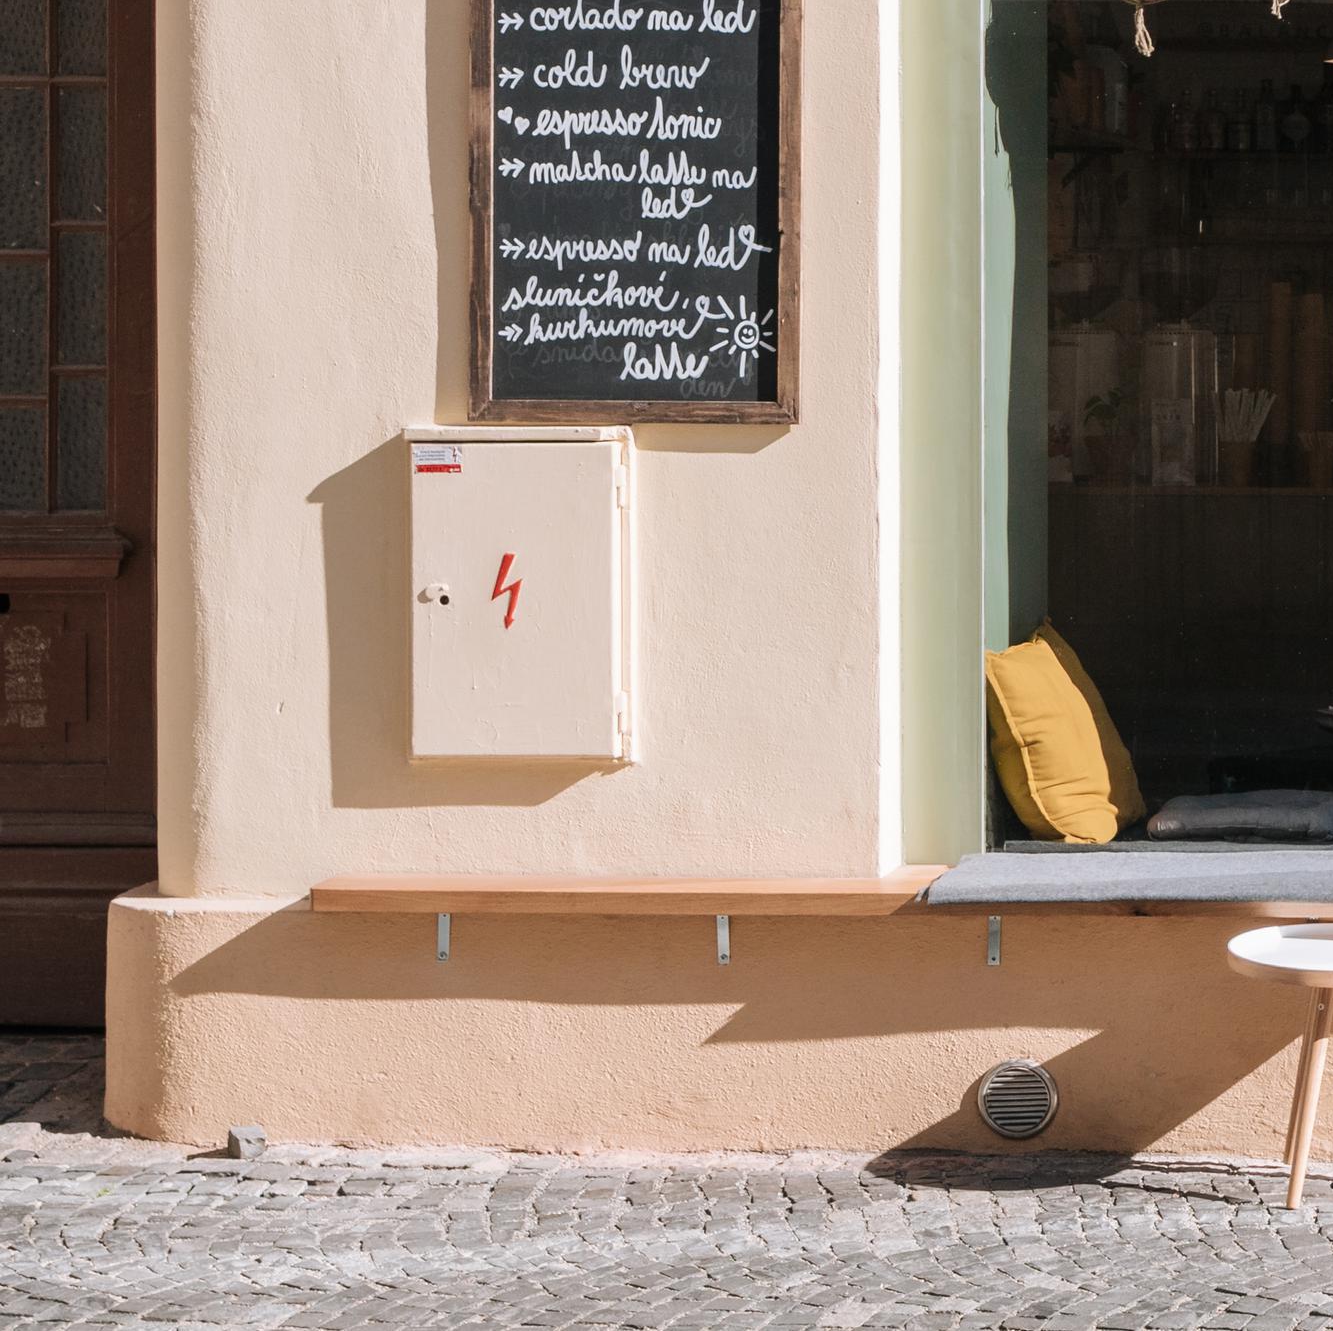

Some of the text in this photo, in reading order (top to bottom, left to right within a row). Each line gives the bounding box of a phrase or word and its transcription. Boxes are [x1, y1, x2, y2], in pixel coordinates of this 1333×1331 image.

[646, 8, 695, 32] na
[532, 44, 711, 90] cold brew
[531, 95, 723, 150] espresso tonic
[528, 148, 758, 189] matcha latte na
[641, 186, 702, 220] led
[528, 230, 643, 271] espresso
[647, 242, 691, 264] na
[693, 224, 764, 271] led
[619, 341, 711, 381] latte
